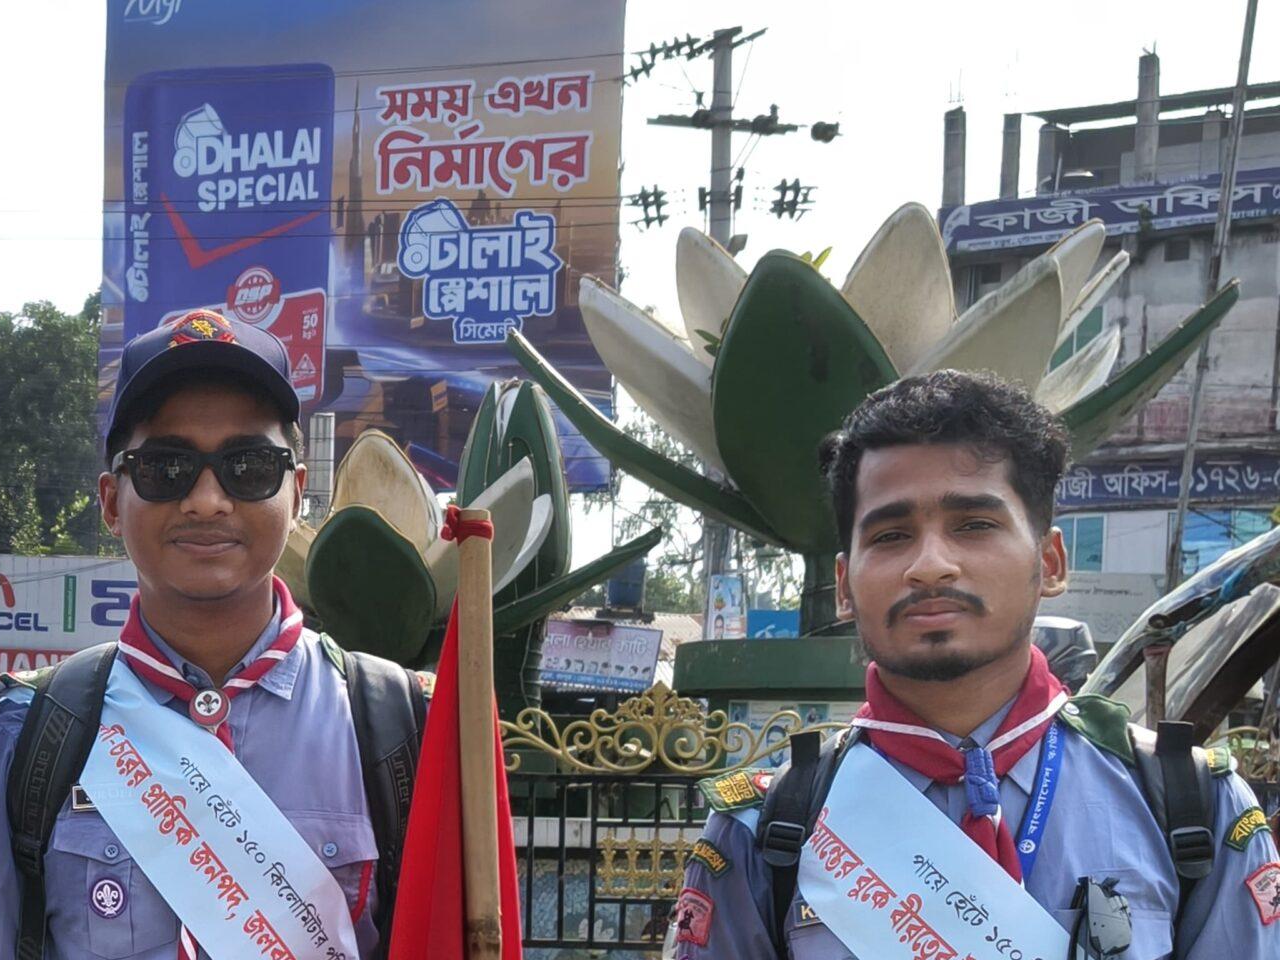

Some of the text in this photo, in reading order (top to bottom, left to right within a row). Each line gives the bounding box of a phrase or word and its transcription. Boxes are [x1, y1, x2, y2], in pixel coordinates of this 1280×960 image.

[379, 73, 592, 125] সময় এখন
[196, 127, 320, 177] DHALAI
[377, 124, 591, 194] নির্মাণের
[197, 170, 319, 213] SPECIAL
[974, 198, 1100, 233] কাজী
[1112, 185, 1272, 216] অফিস
[402, 210, 557, 272] ঢালাই
[188, 840, 249, 919] জনপদ,
[236, 830, 266, 864] ১৫০
[263, 861, 329, 949] কিলোমিটার
[848, 868, 898, 909] বুকে
